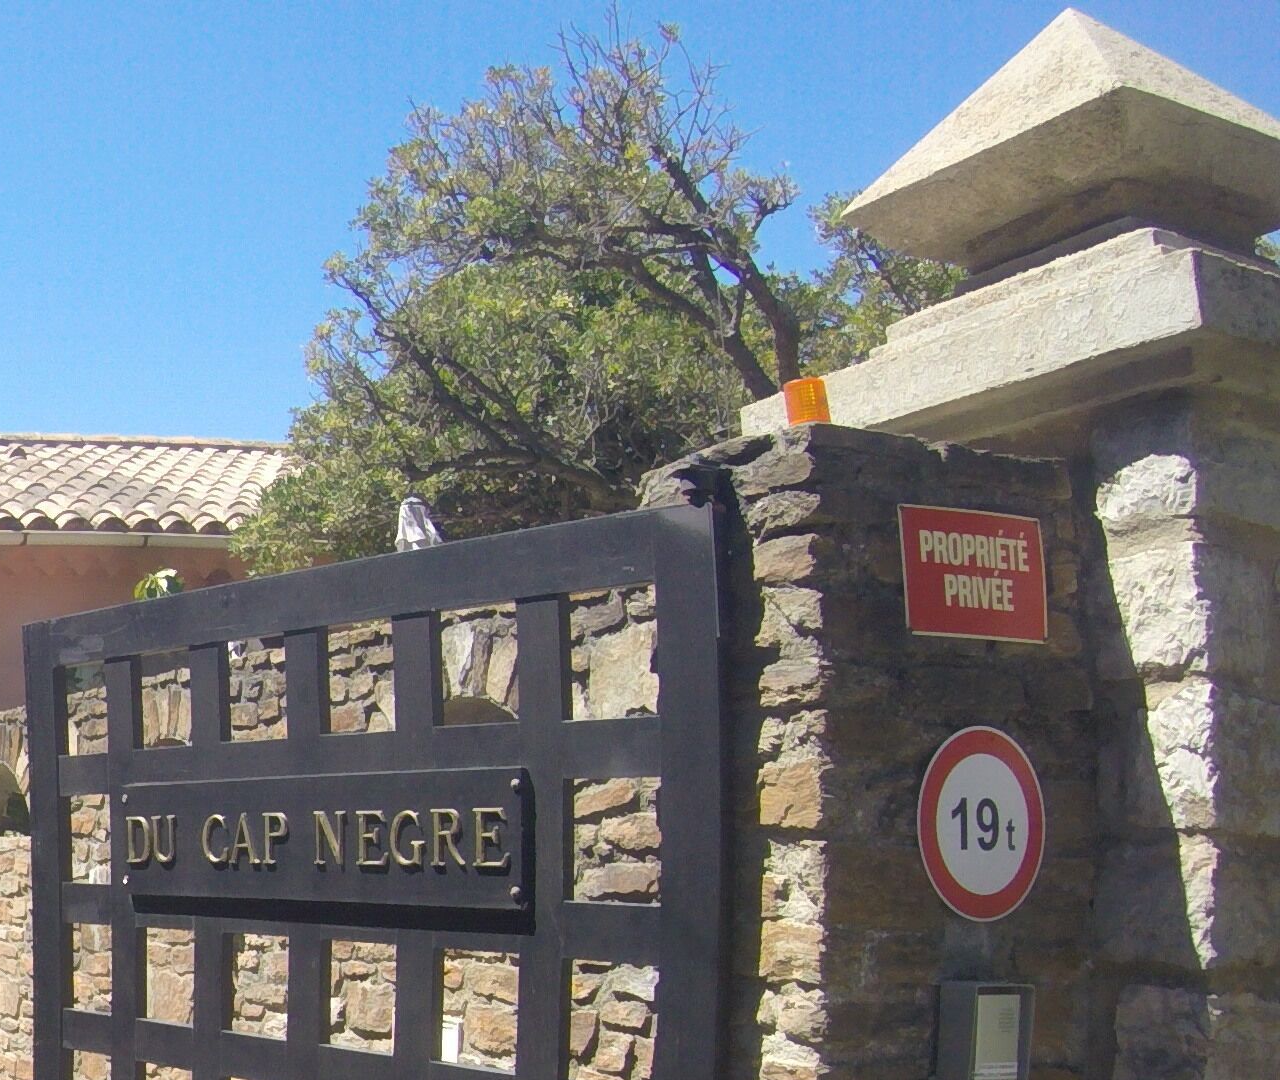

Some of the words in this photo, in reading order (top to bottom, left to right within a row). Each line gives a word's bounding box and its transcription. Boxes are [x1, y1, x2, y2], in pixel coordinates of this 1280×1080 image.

[918, 529, 1030, 573] PROPRIÉTÉ
[943, 570, 1015, 612] PRIVÉE
[126, 813, 177, 864] DU
[200, 811, 289, 865] CAP
[312, 806, 512, 868] NEGRE
